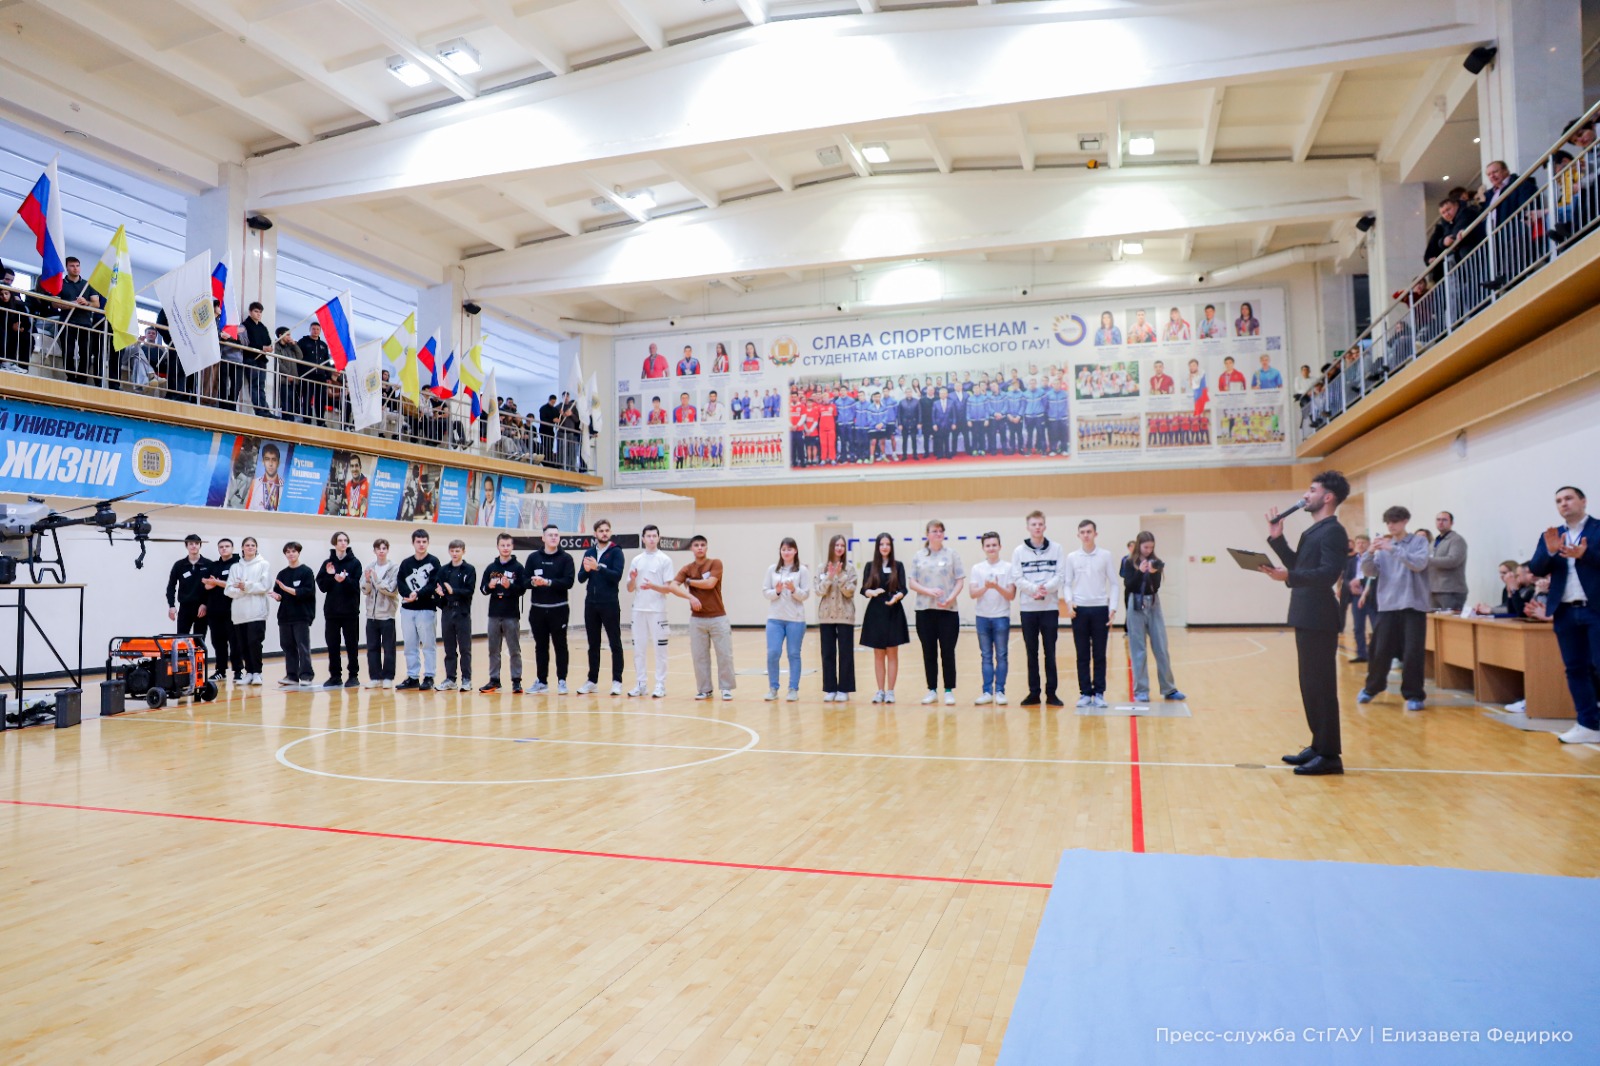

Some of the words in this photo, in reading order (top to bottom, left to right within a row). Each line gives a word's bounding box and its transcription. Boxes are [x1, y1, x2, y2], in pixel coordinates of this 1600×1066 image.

[812, 332, 874, 351] СЛАВА
[879, 320, 1027, 346] СПОРТСМЕНАМ
[802, 350, 878, 367] СТУДЕНТАМ
[881, 340, 1018, 361] СТАВРОПОЛЬСКОГО
[1022, 338, 1050, 351] ГАУ!
[12, 413, 122, 445] УНИВЕРСИТЕТ
[0, 440, 122, 487] ЖИЗНИ
